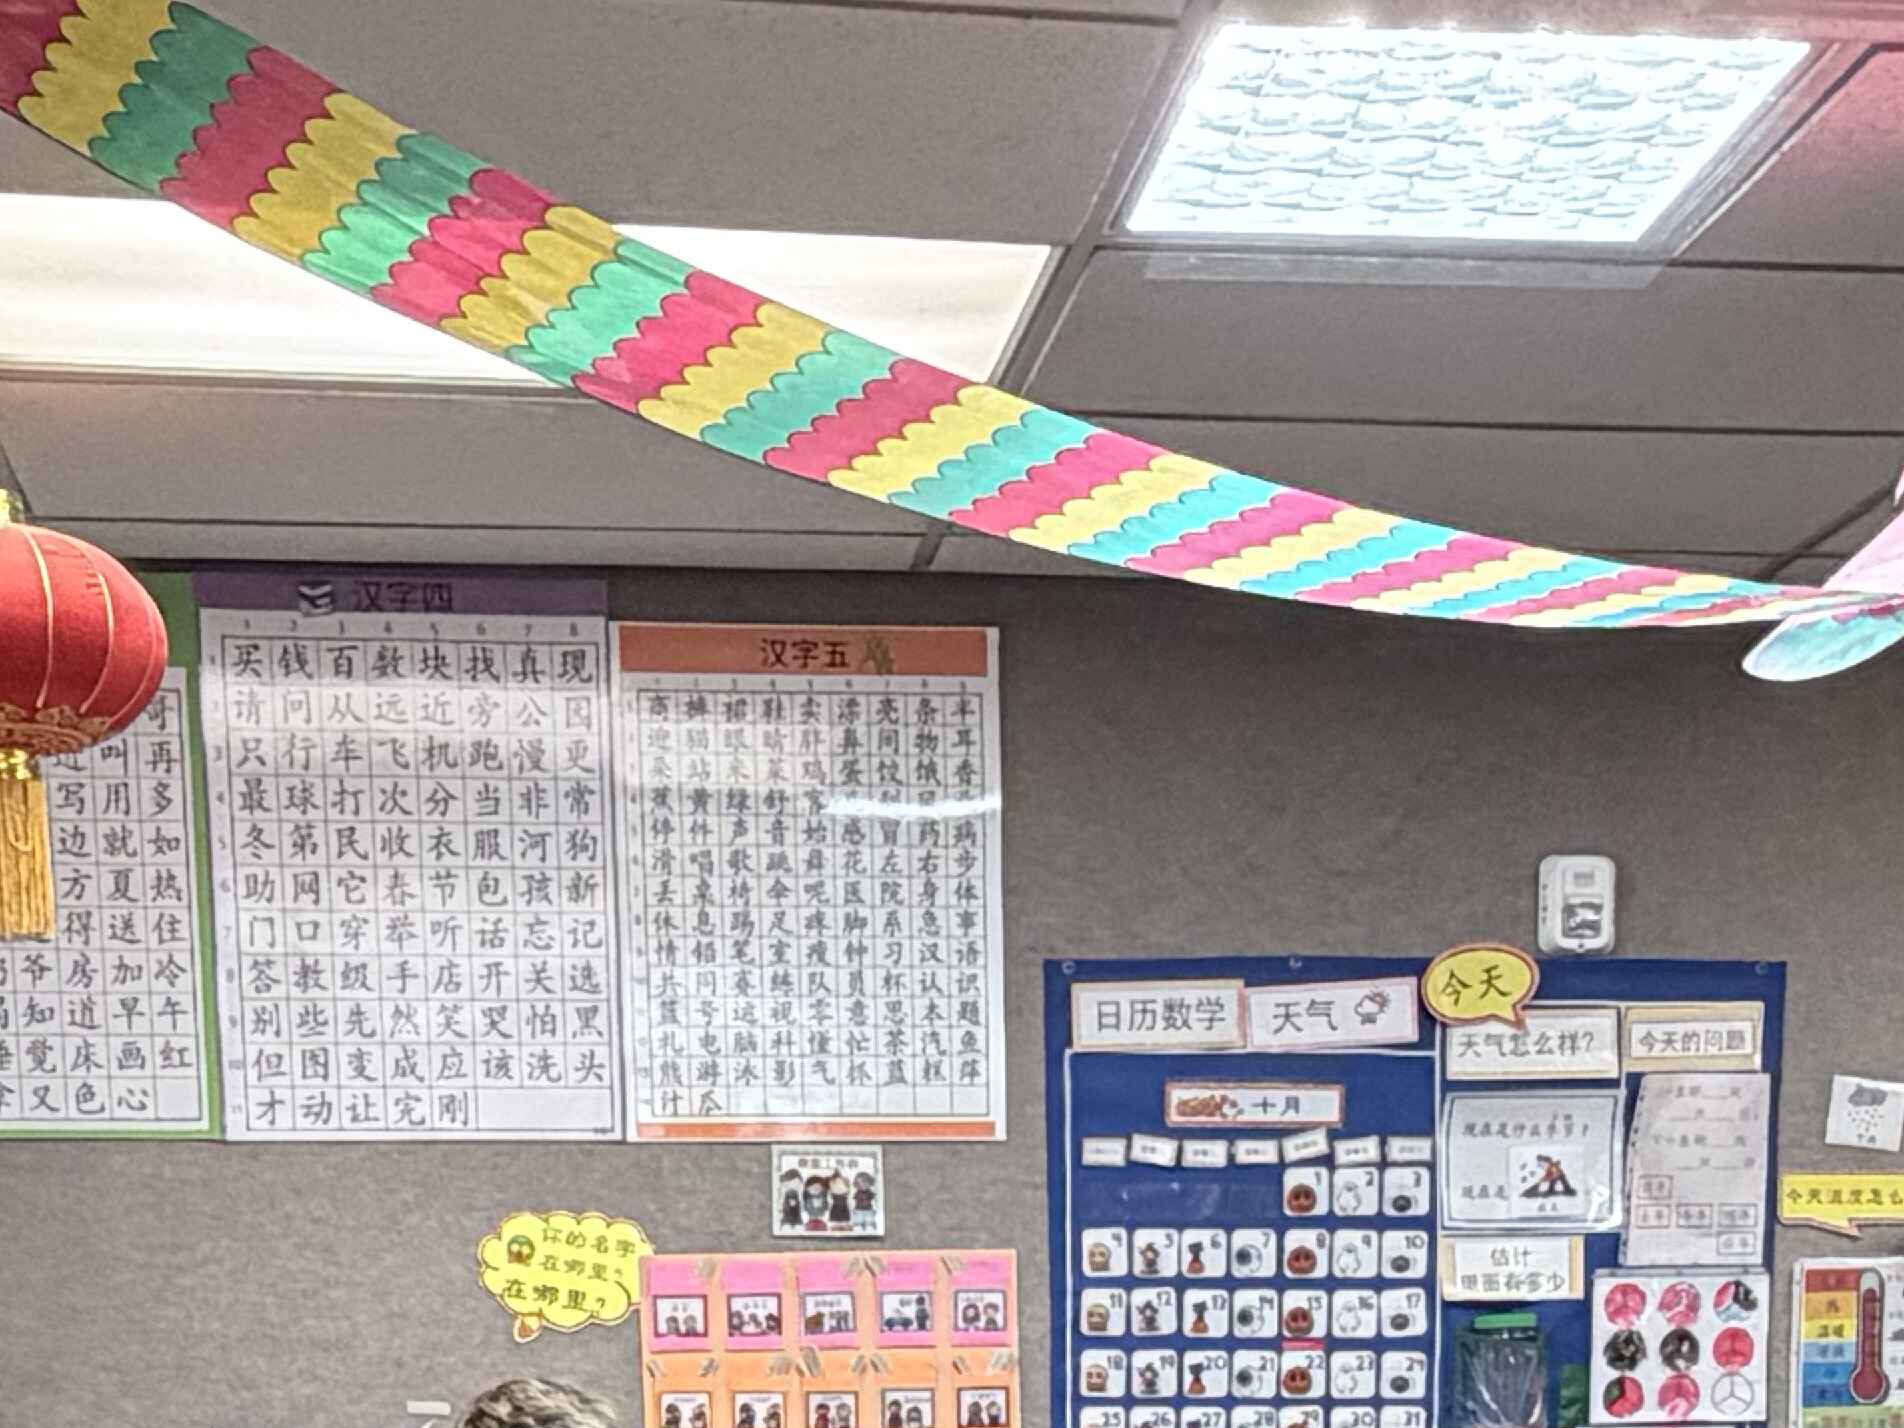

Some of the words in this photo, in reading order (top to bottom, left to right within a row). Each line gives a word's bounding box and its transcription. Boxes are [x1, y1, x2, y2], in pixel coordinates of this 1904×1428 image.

[760, 638, 850, 670] 汉字五
[1438, 963, 1513, 1007] 今天
[1096, 996, 1227, 1033] 日历数学
[1272, 997, 1340, 1035] 天气
